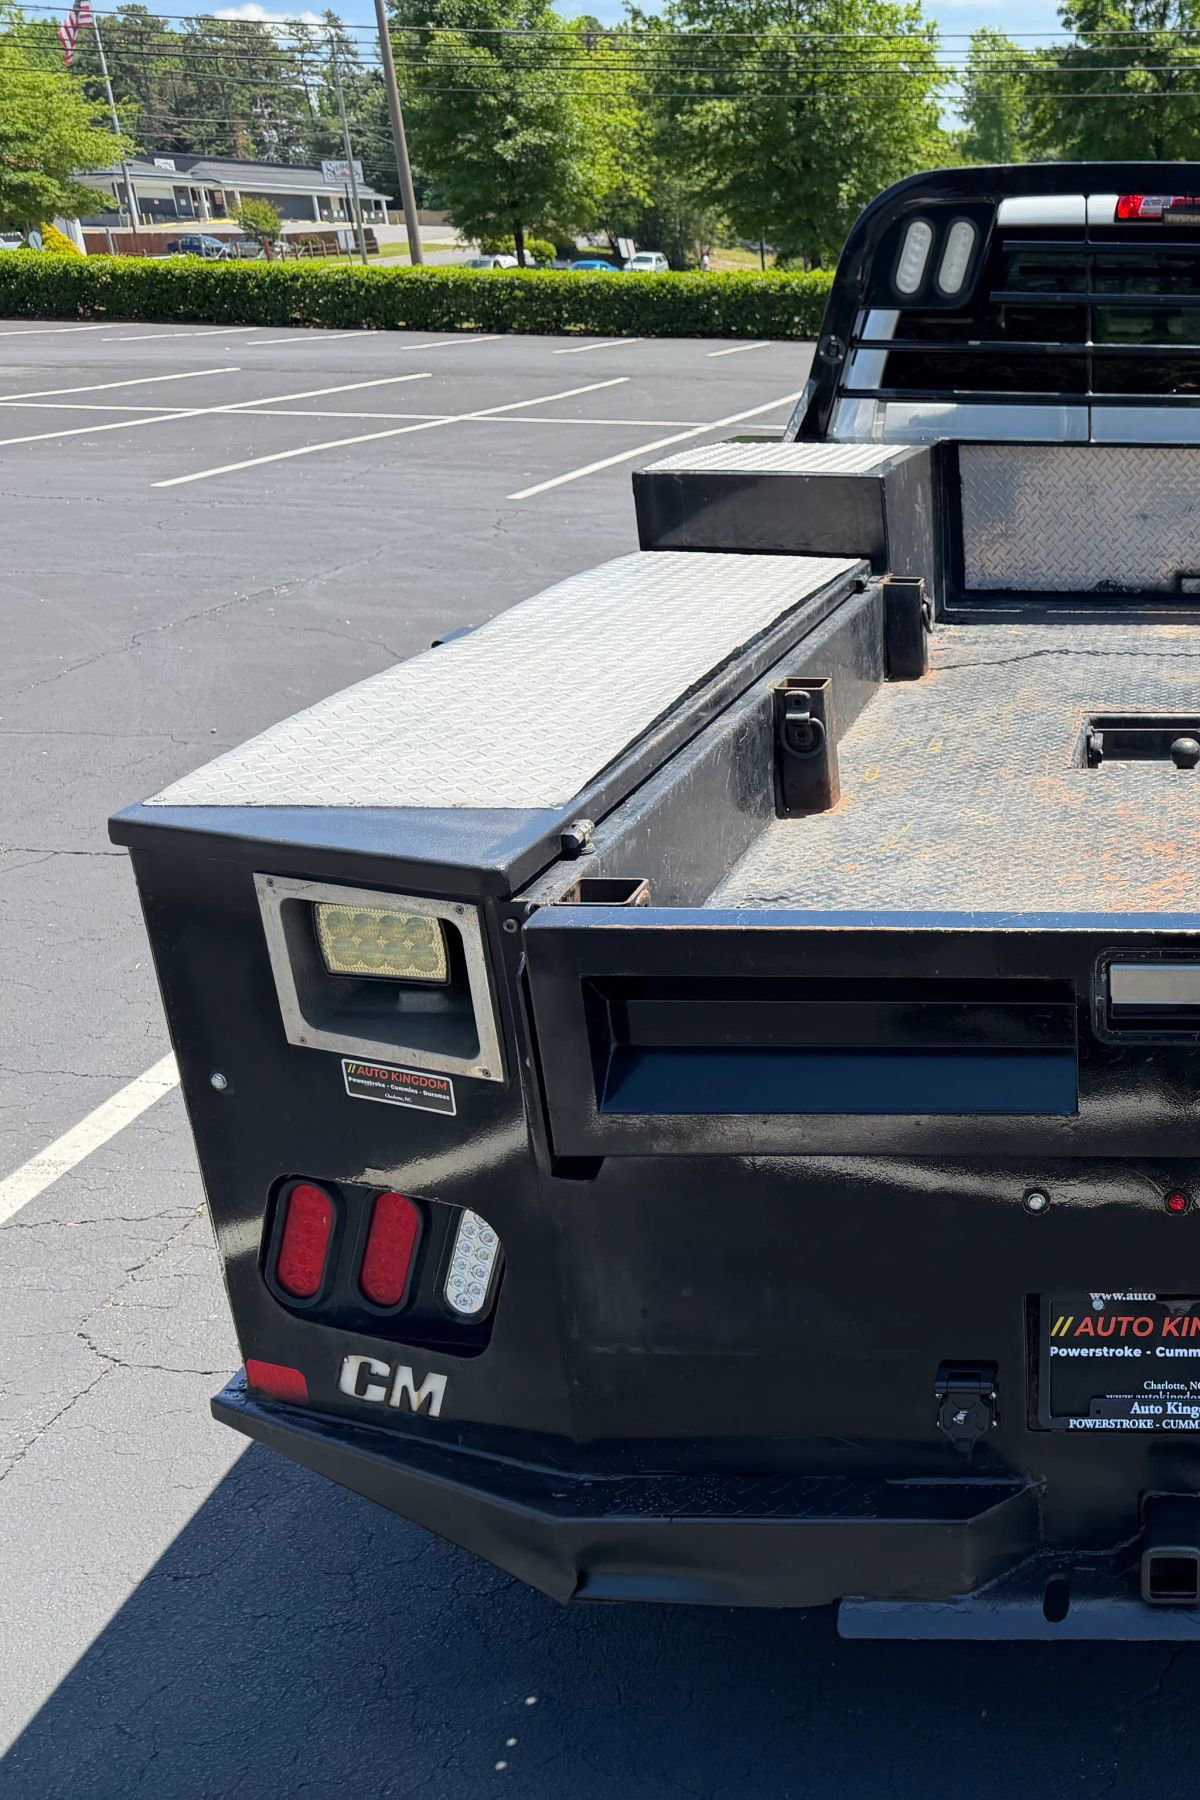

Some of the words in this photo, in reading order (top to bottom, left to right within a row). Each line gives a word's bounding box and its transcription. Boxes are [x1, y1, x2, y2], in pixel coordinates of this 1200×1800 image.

[391, 1072, 448, 1090] KINGDOM
[348, 1077, 386, 1088] Powerstroke
[391, 1084, 418, 1094] Cummins
[423, 1090, 450, 1100] Duramax
[1050, 1346, 1142, 1357] Powerstroke
[339, 1354, 448, 1417] CM
[1143, 1381, 1188, 1391] Charlotte,
[1130, 1402, 1163, 1415] Auto
[1069, 1419, 1154, 1429] POWERSTROKE
